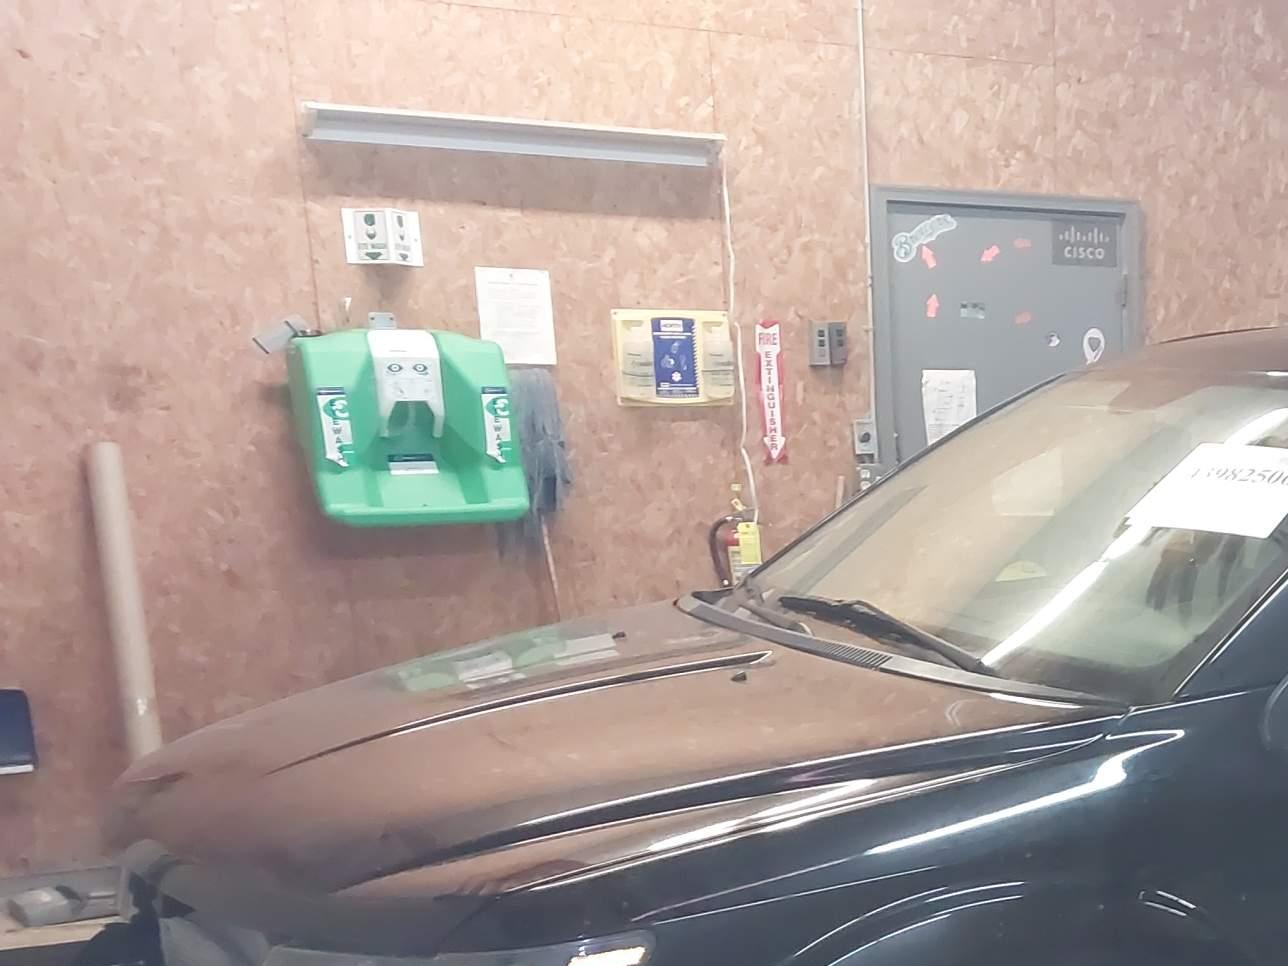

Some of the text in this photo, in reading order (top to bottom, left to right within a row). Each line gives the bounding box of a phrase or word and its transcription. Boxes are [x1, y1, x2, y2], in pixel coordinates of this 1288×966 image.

[1064, 246, 1105, 259] CISCO
[758, 332, 778, 346] FIRE
[764, 351, 778, 450] EXTINGUISHER
